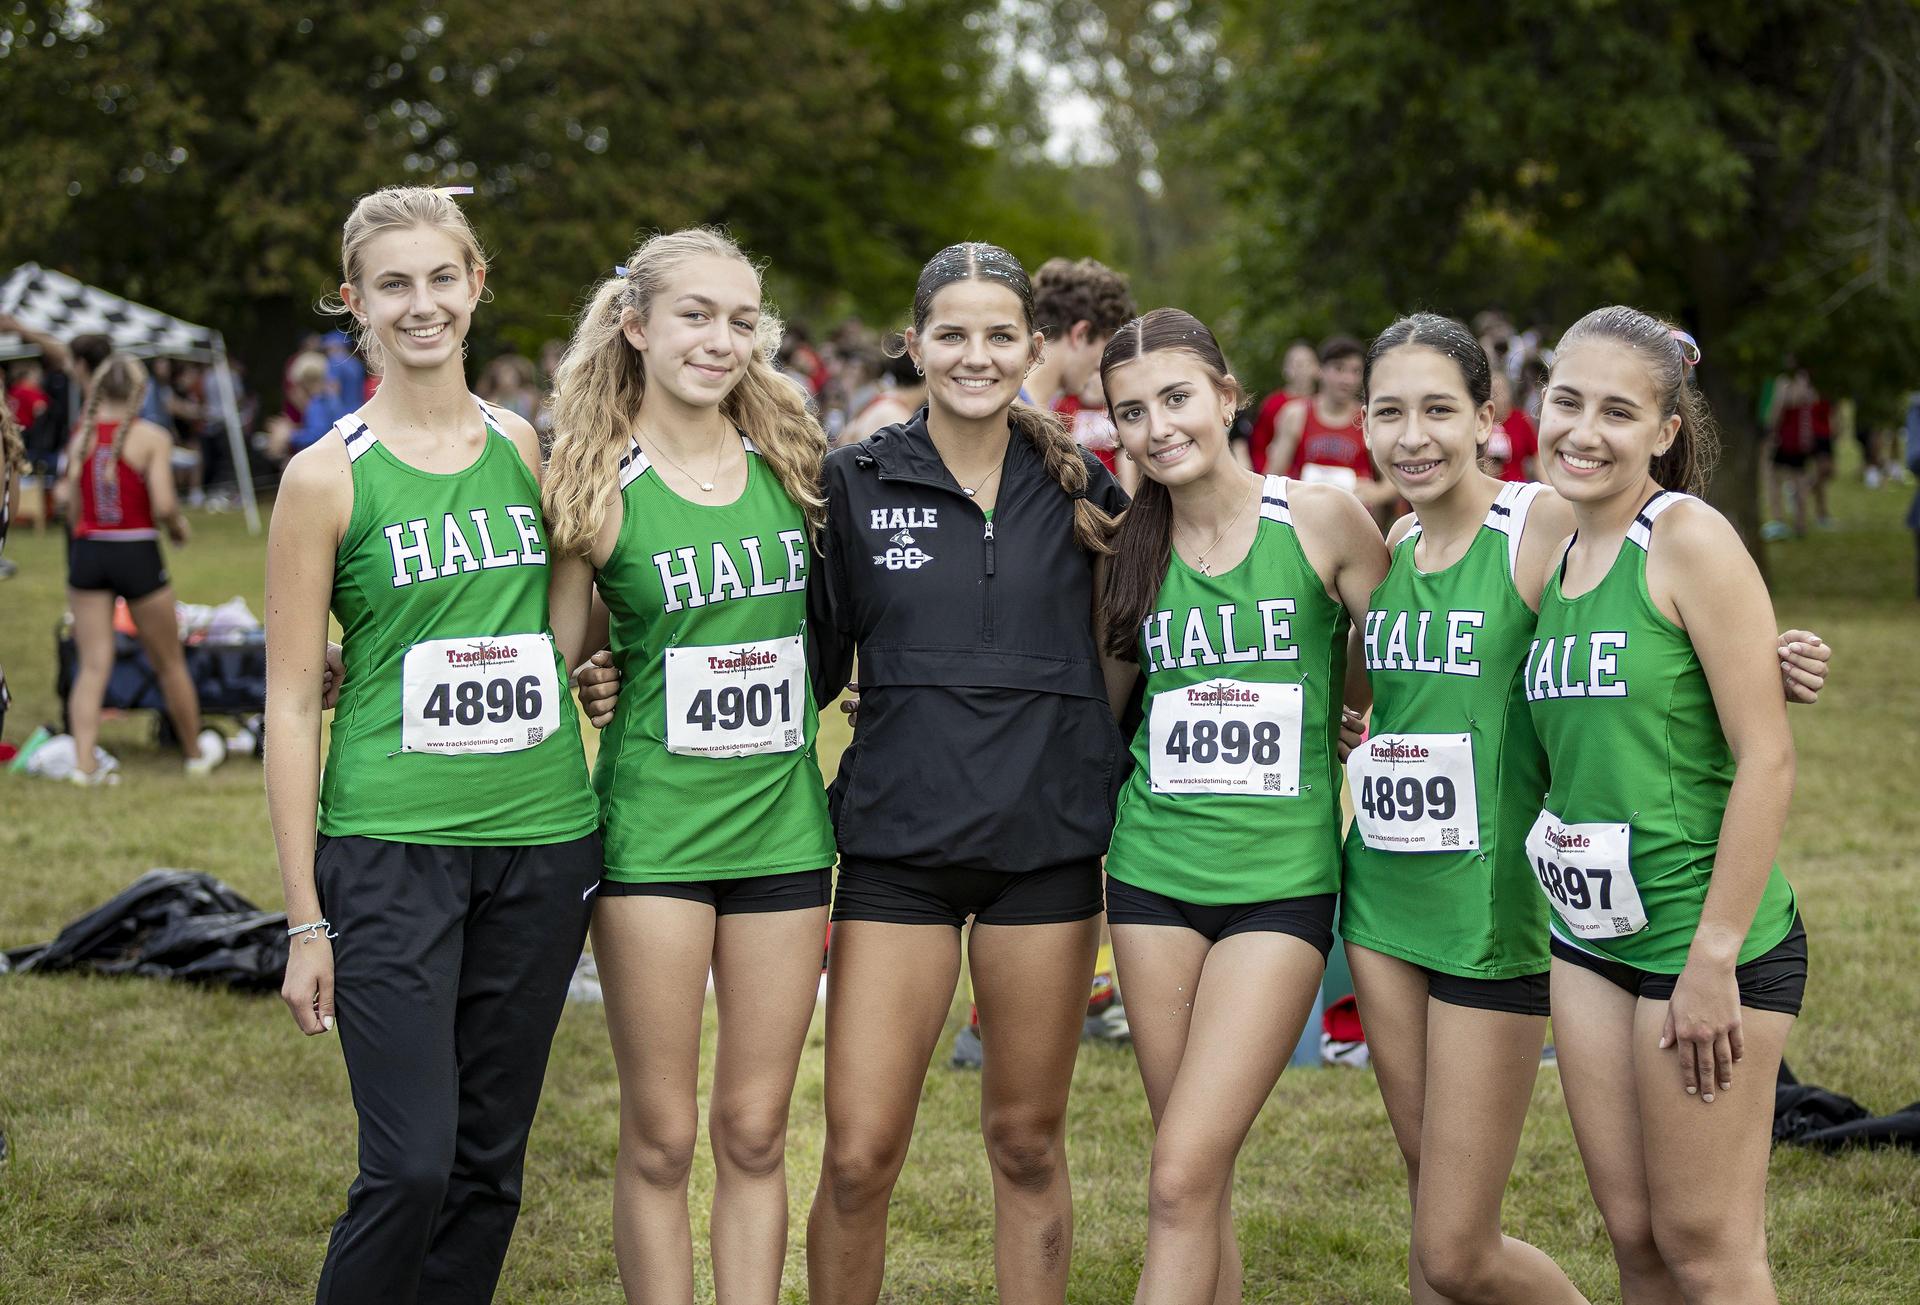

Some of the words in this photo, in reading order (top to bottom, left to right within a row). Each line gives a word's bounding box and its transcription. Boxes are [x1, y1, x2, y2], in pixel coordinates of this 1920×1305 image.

[871, 507, 938, 529] HALE
[383, 505, 547, 589] HALE
[886, 548, 922, 570] CC
[652, 529, 807, 614] HALE
[446, 646, 518, 663] TrackSide
[1142, 598, 1300, 674] HALE
[1364, 610, 1485, 677] HALE
[708, 651, 777, 669] TrackSide
[422, 674, 543, 727] 4896
[686, 679, 791, 732] 4901
[1187, 688, 1260, 703] TrackSide
[1165, 719, 1281, 766] 4898
[1361, 775, 1457, 822] 4899
[1544, 825, 1591, 848] TraSide
[1537, 856, 1613, 910] 4897
